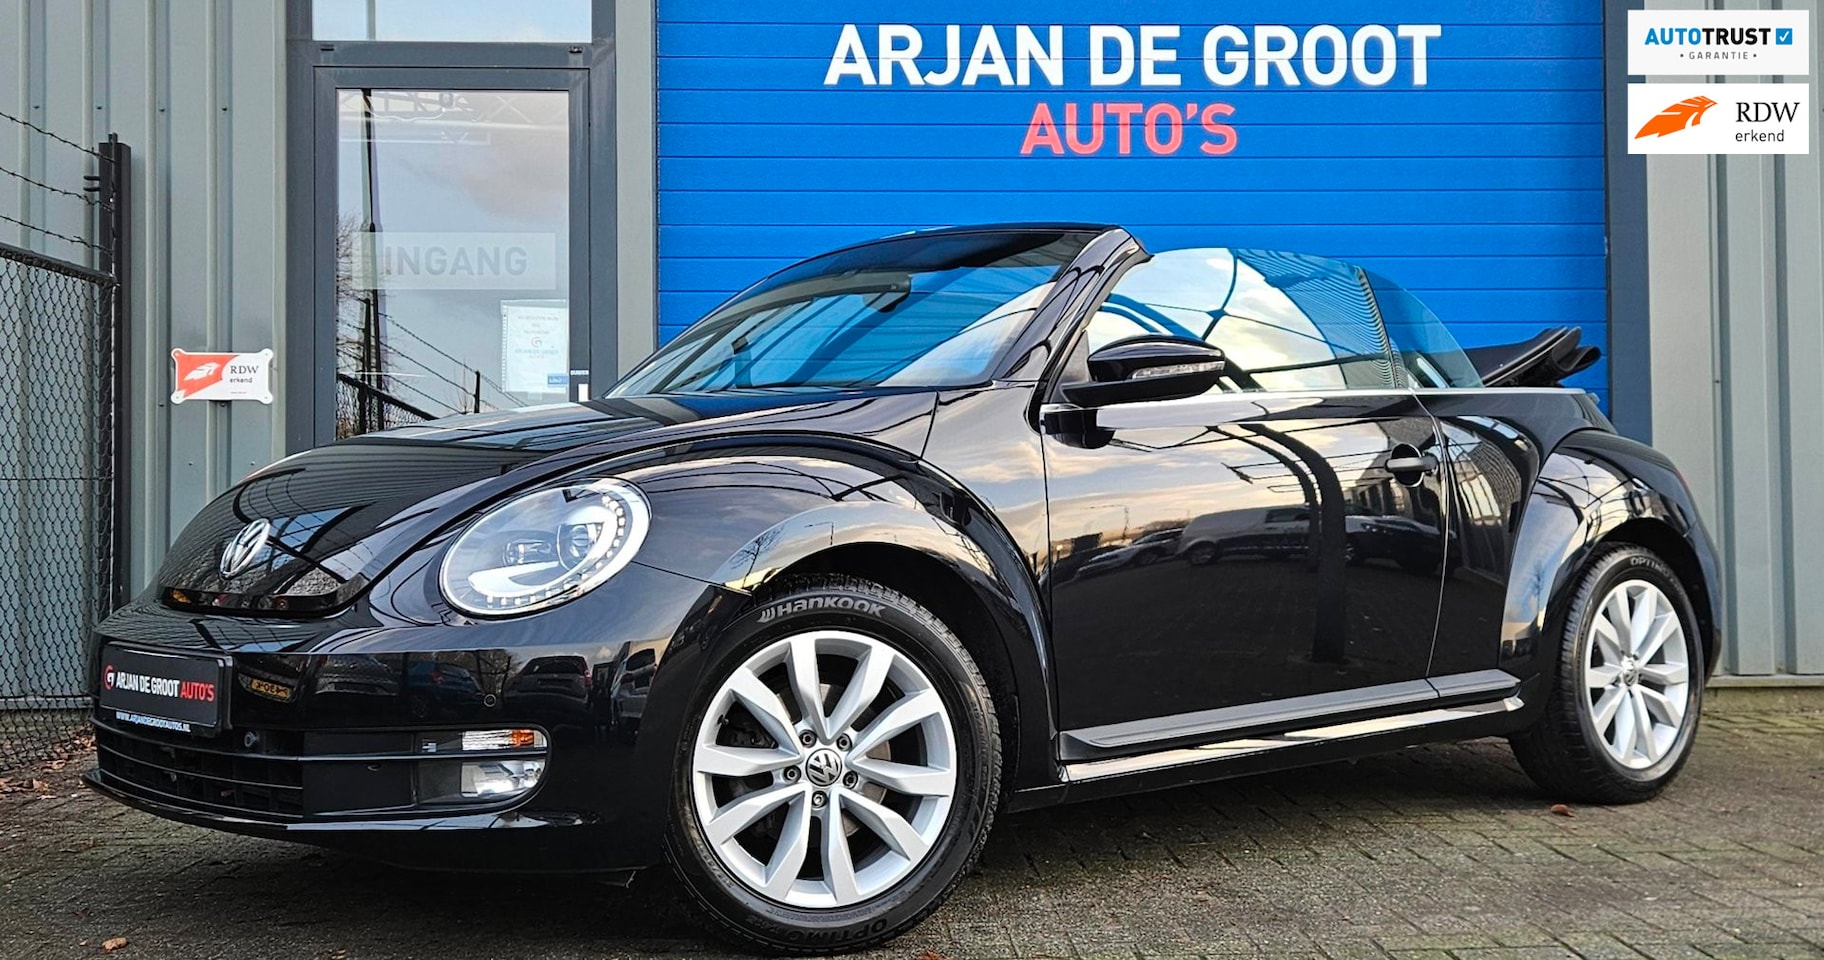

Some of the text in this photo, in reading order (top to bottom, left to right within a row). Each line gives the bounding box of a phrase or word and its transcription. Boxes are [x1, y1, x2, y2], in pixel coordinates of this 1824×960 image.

[823, 23, 1443, 87] ARJAN DE GROOT
[1020, 102, 1239, 155] AUTO'S
[383, 246, 528, 276] INGANG
[229, 365, 260, 375] RDW
[229, 376, 253, 384] erkend
[115, 671, 215, 702] ARJAN DE GROOT AUTO'S
